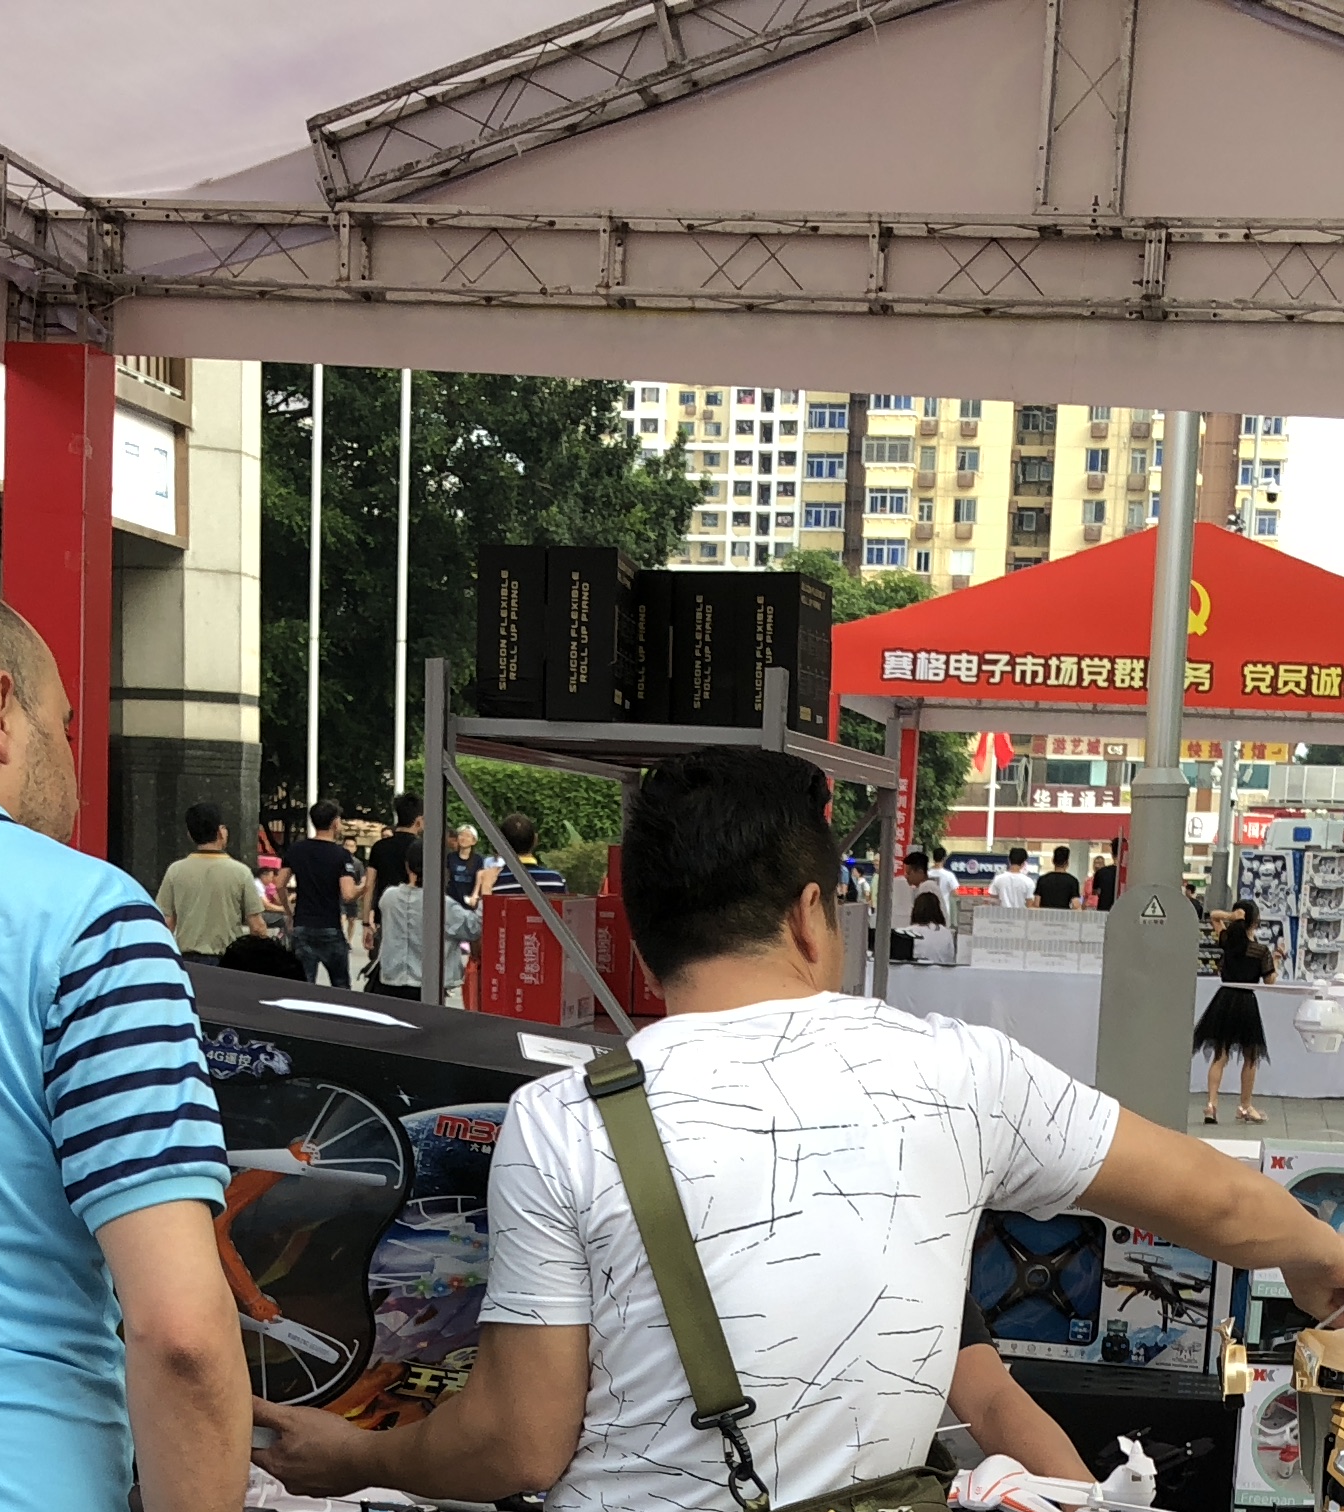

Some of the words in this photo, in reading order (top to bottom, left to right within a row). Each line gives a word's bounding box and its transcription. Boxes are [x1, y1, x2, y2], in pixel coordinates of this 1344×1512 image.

[499, 569, 509, 635] FLEXIBLE
[510, 580, 519, 620] PIANO
[570, 571, 580, 637] FLEXIBLE
[580, 582, 590, 622] PIANO
[510, 623, 518, 641] UP
[580, 625, 589, 643] UP
[638, 604, 647, 641] PIANO
[694, 594, 704, 656] FLEXIBLE
[704, 604, 713, 641] PIANO
[755, 595, 765, 658] FLEXIBLE
[765, 605, 774, 643] PIANO
[498, 639, 508, 691] SILICON
[509, 645, 518, 681] ROLL
[568, 641, 578, 693] SILICON
[579, 647, 589, 683] ROLL
[638, 645, 646, 662] UP
[704, 645, 712, 662] UP
[765, 646, 773, 663] UP
[882, 648, 1213, 692] 赛格电子市场党群务
[637, 666, 646, 700] ROLL
[693, 660, 702, 709] SILICON
[703, 666, 712, 700] ROLL
[754, 661, 763, 711] SILICON
